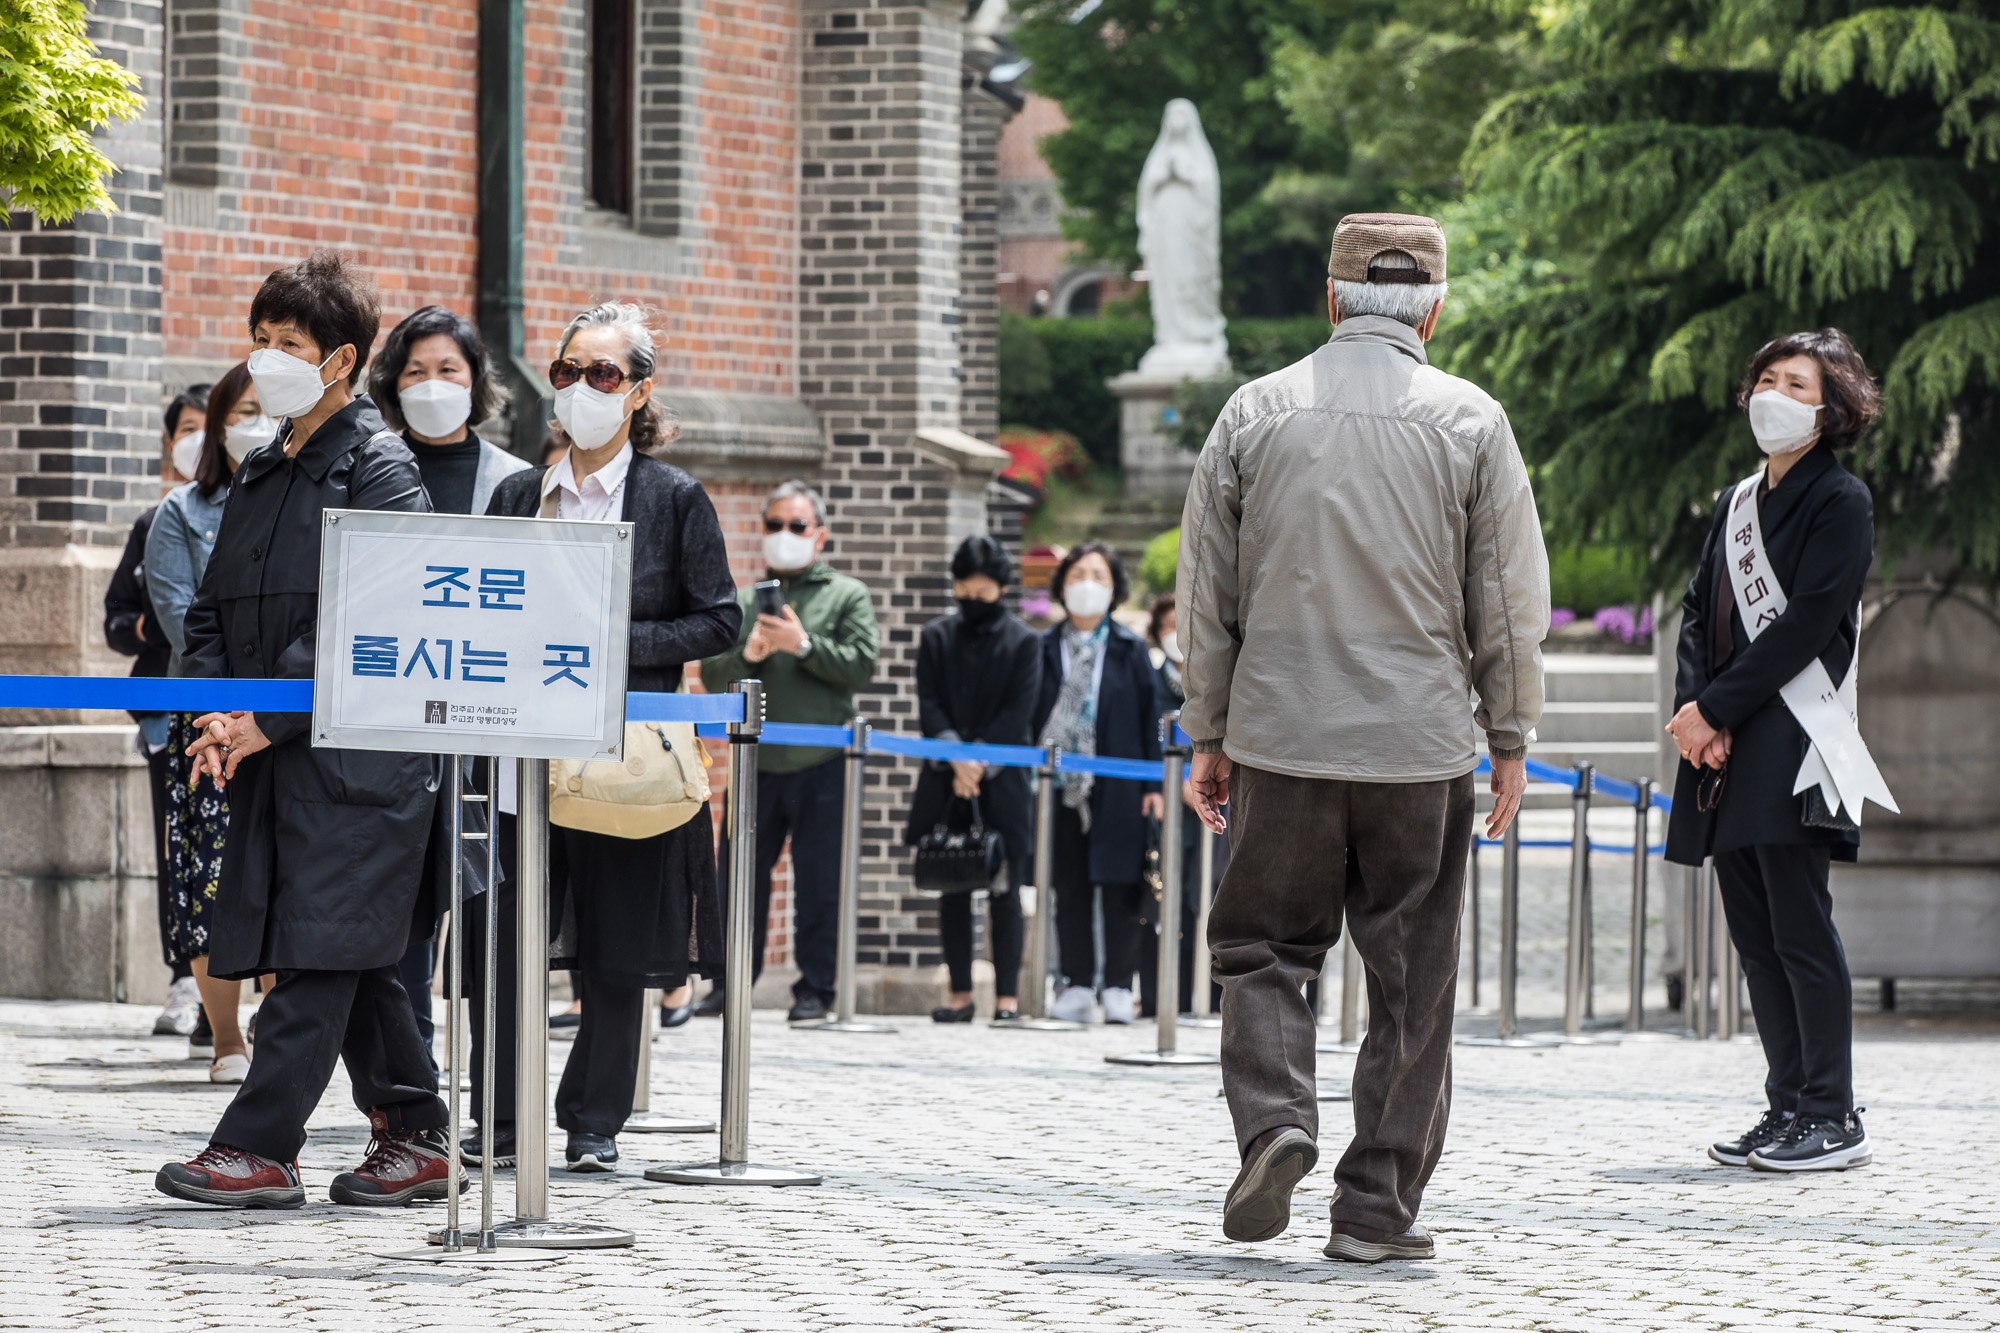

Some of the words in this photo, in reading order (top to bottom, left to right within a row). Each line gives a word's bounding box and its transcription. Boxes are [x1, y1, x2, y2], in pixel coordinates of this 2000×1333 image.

[422, 565, 526, 610] 조문
[352, 635, 508, 683] 줄서는
[543, 644, 590, 689] 곳
[450, 704, 475, 713] 천주교
[476, 706, 517, 715] 서울대교구
[450, 715, 475, 723] 주교좌
[476, 716, 517, 725] 명동대성당
